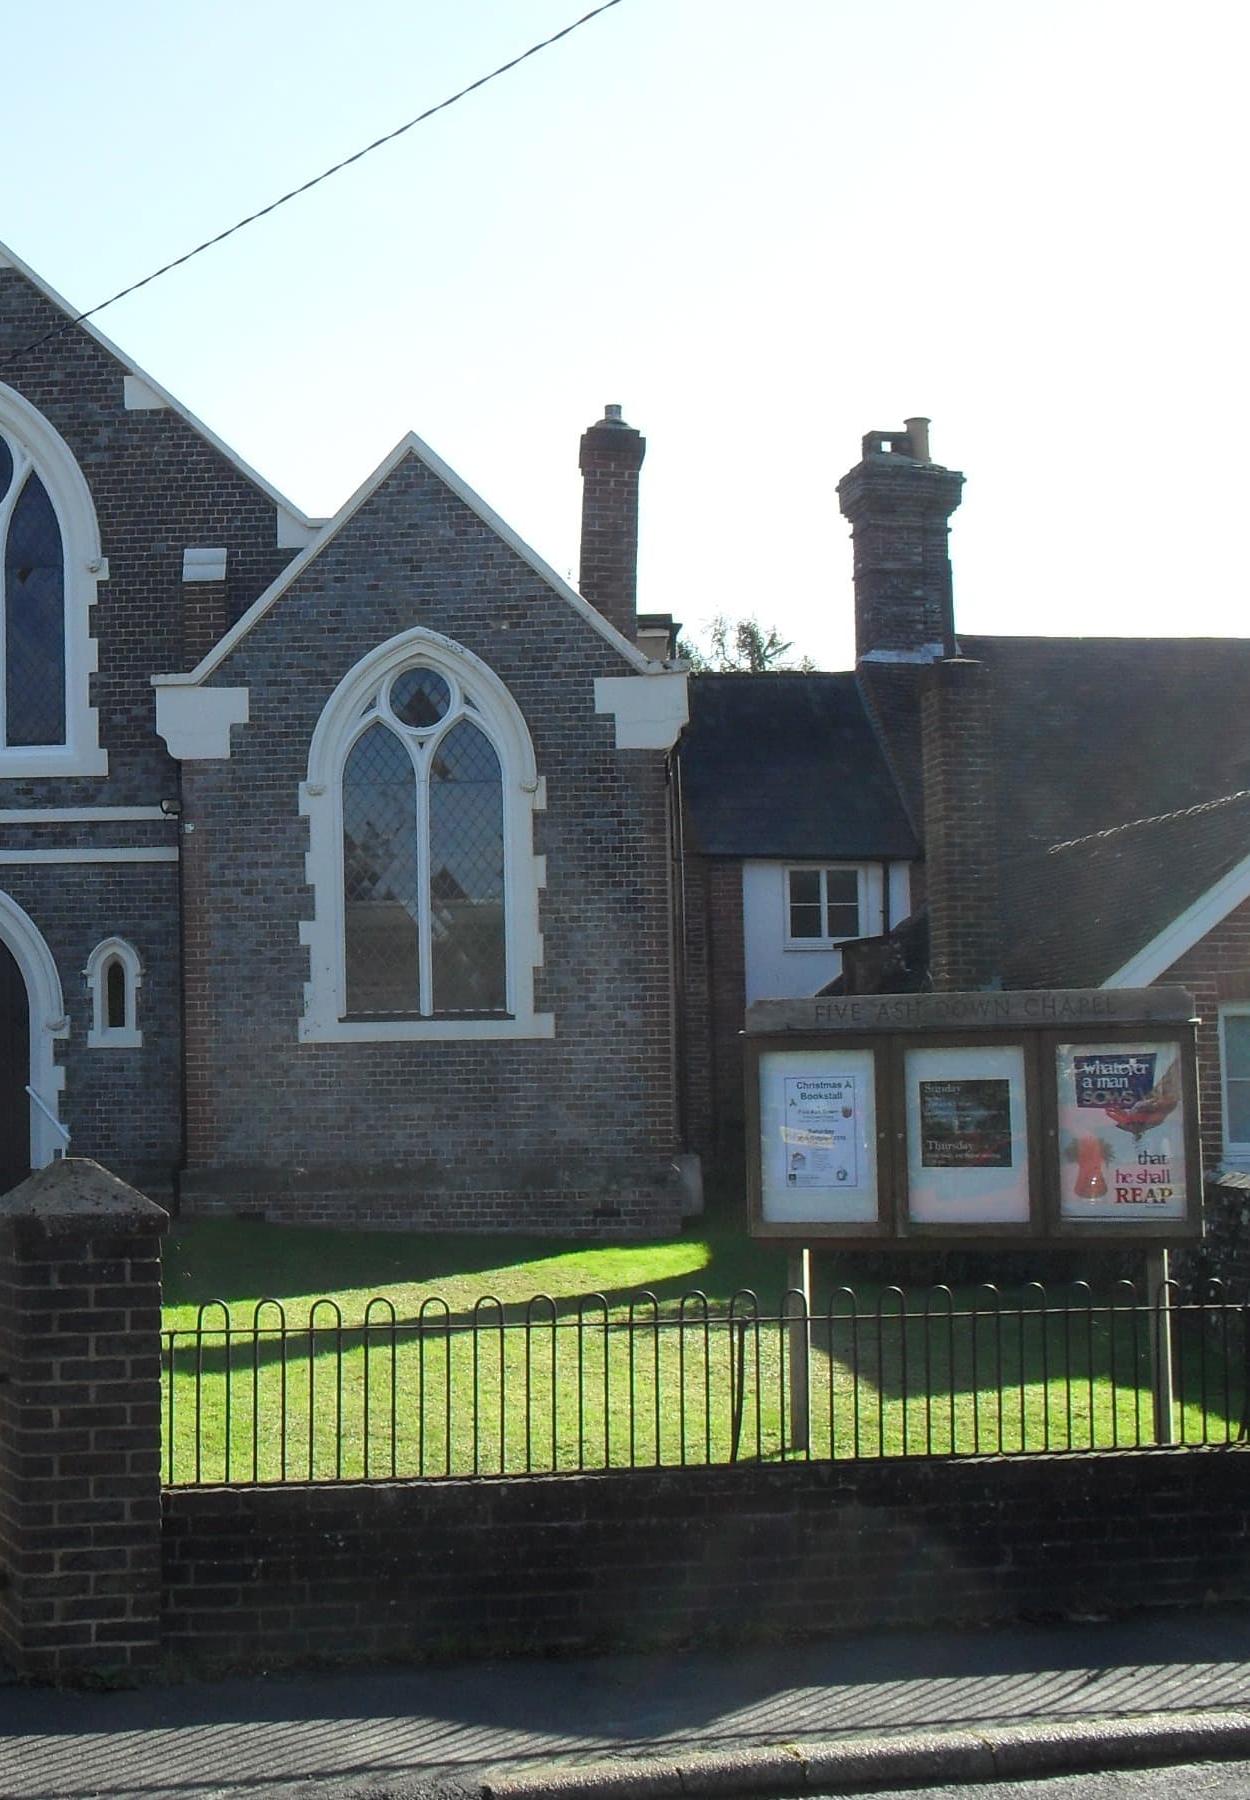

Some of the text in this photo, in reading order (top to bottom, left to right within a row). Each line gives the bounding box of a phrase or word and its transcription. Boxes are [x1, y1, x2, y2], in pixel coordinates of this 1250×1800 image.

[814, 995, 1117, 1023] FIVE ASH DOWN CHAPEL
[1083, 1059, 1149, 1075] whatever
[796, 1081, 842, 1090] Christmas
[924, 1083, 961, 1094] Sunday
[1082, 1077, 1128, 1088] a man
[800, 1092, 843, 1101] Bookstall
[926, 1140, 973, 1152] Thursday
[1138, 1151, 1167, 1165] that
[1115, 1169, 1170, 1184] he shall
[1115, 1187, 1173, 1204] REAP
